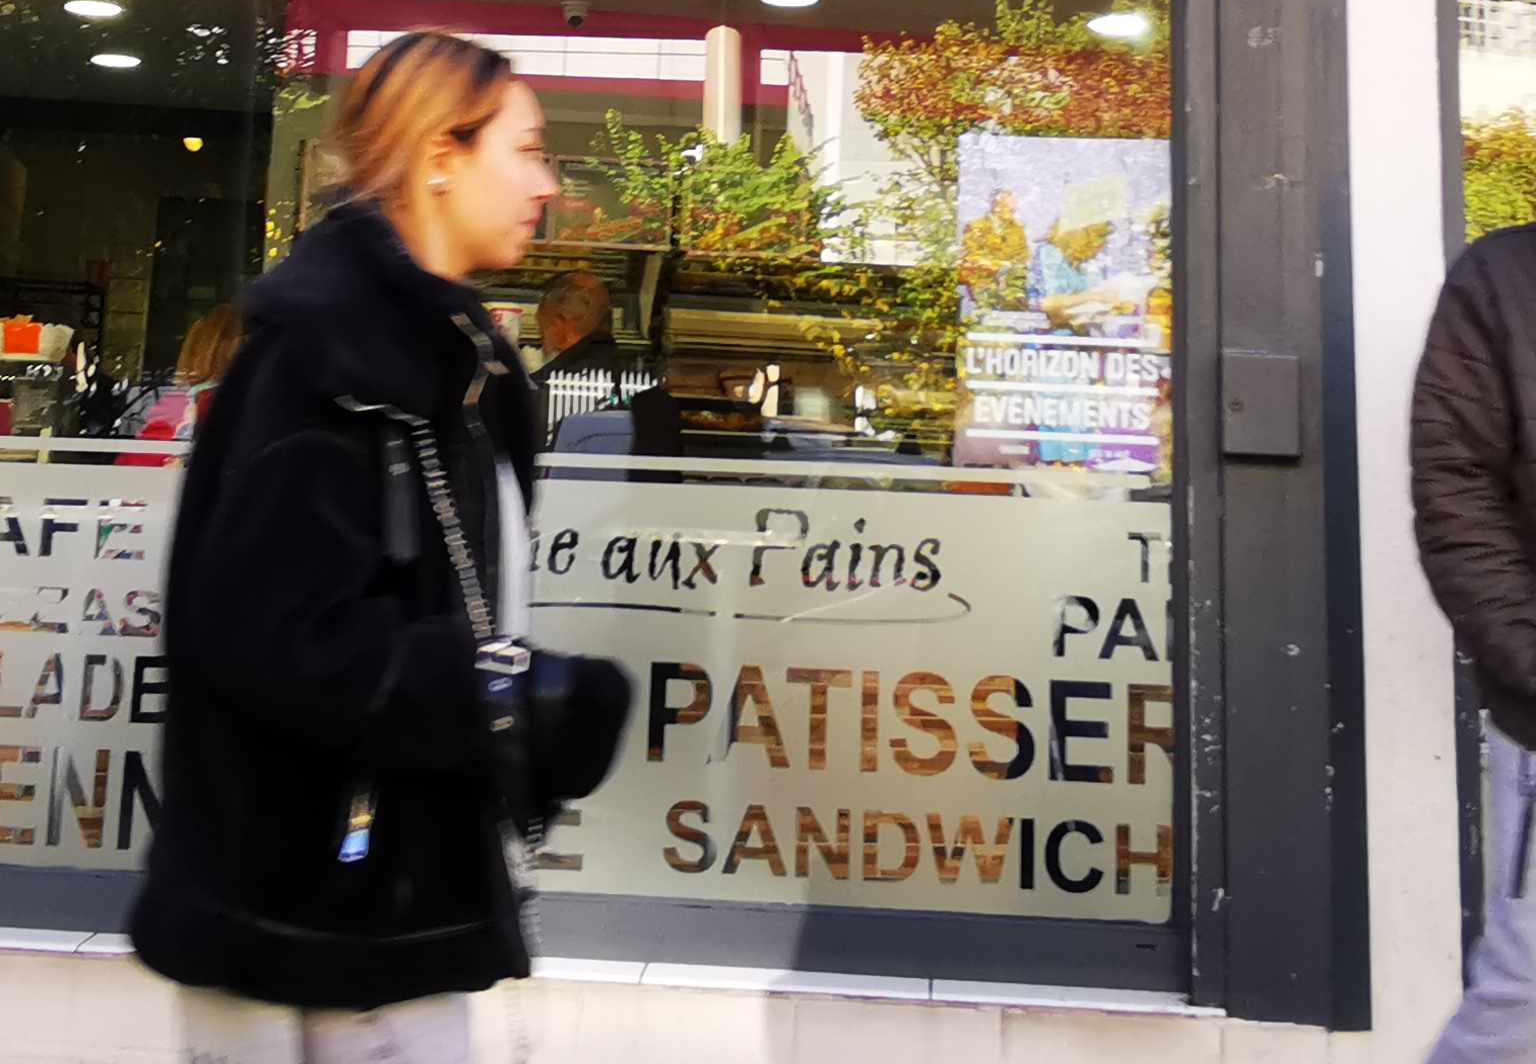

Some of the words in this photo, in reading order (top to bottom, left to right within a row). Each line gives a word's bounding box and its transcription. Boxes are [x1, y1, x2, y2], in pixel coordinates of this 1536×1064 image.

[966, 345, 1099, 379] L'HORIZON
[1105, 352, 1161, 383] DES
[600, 532, 718, 590] aux
[748, 508, 943, 591] Pains
